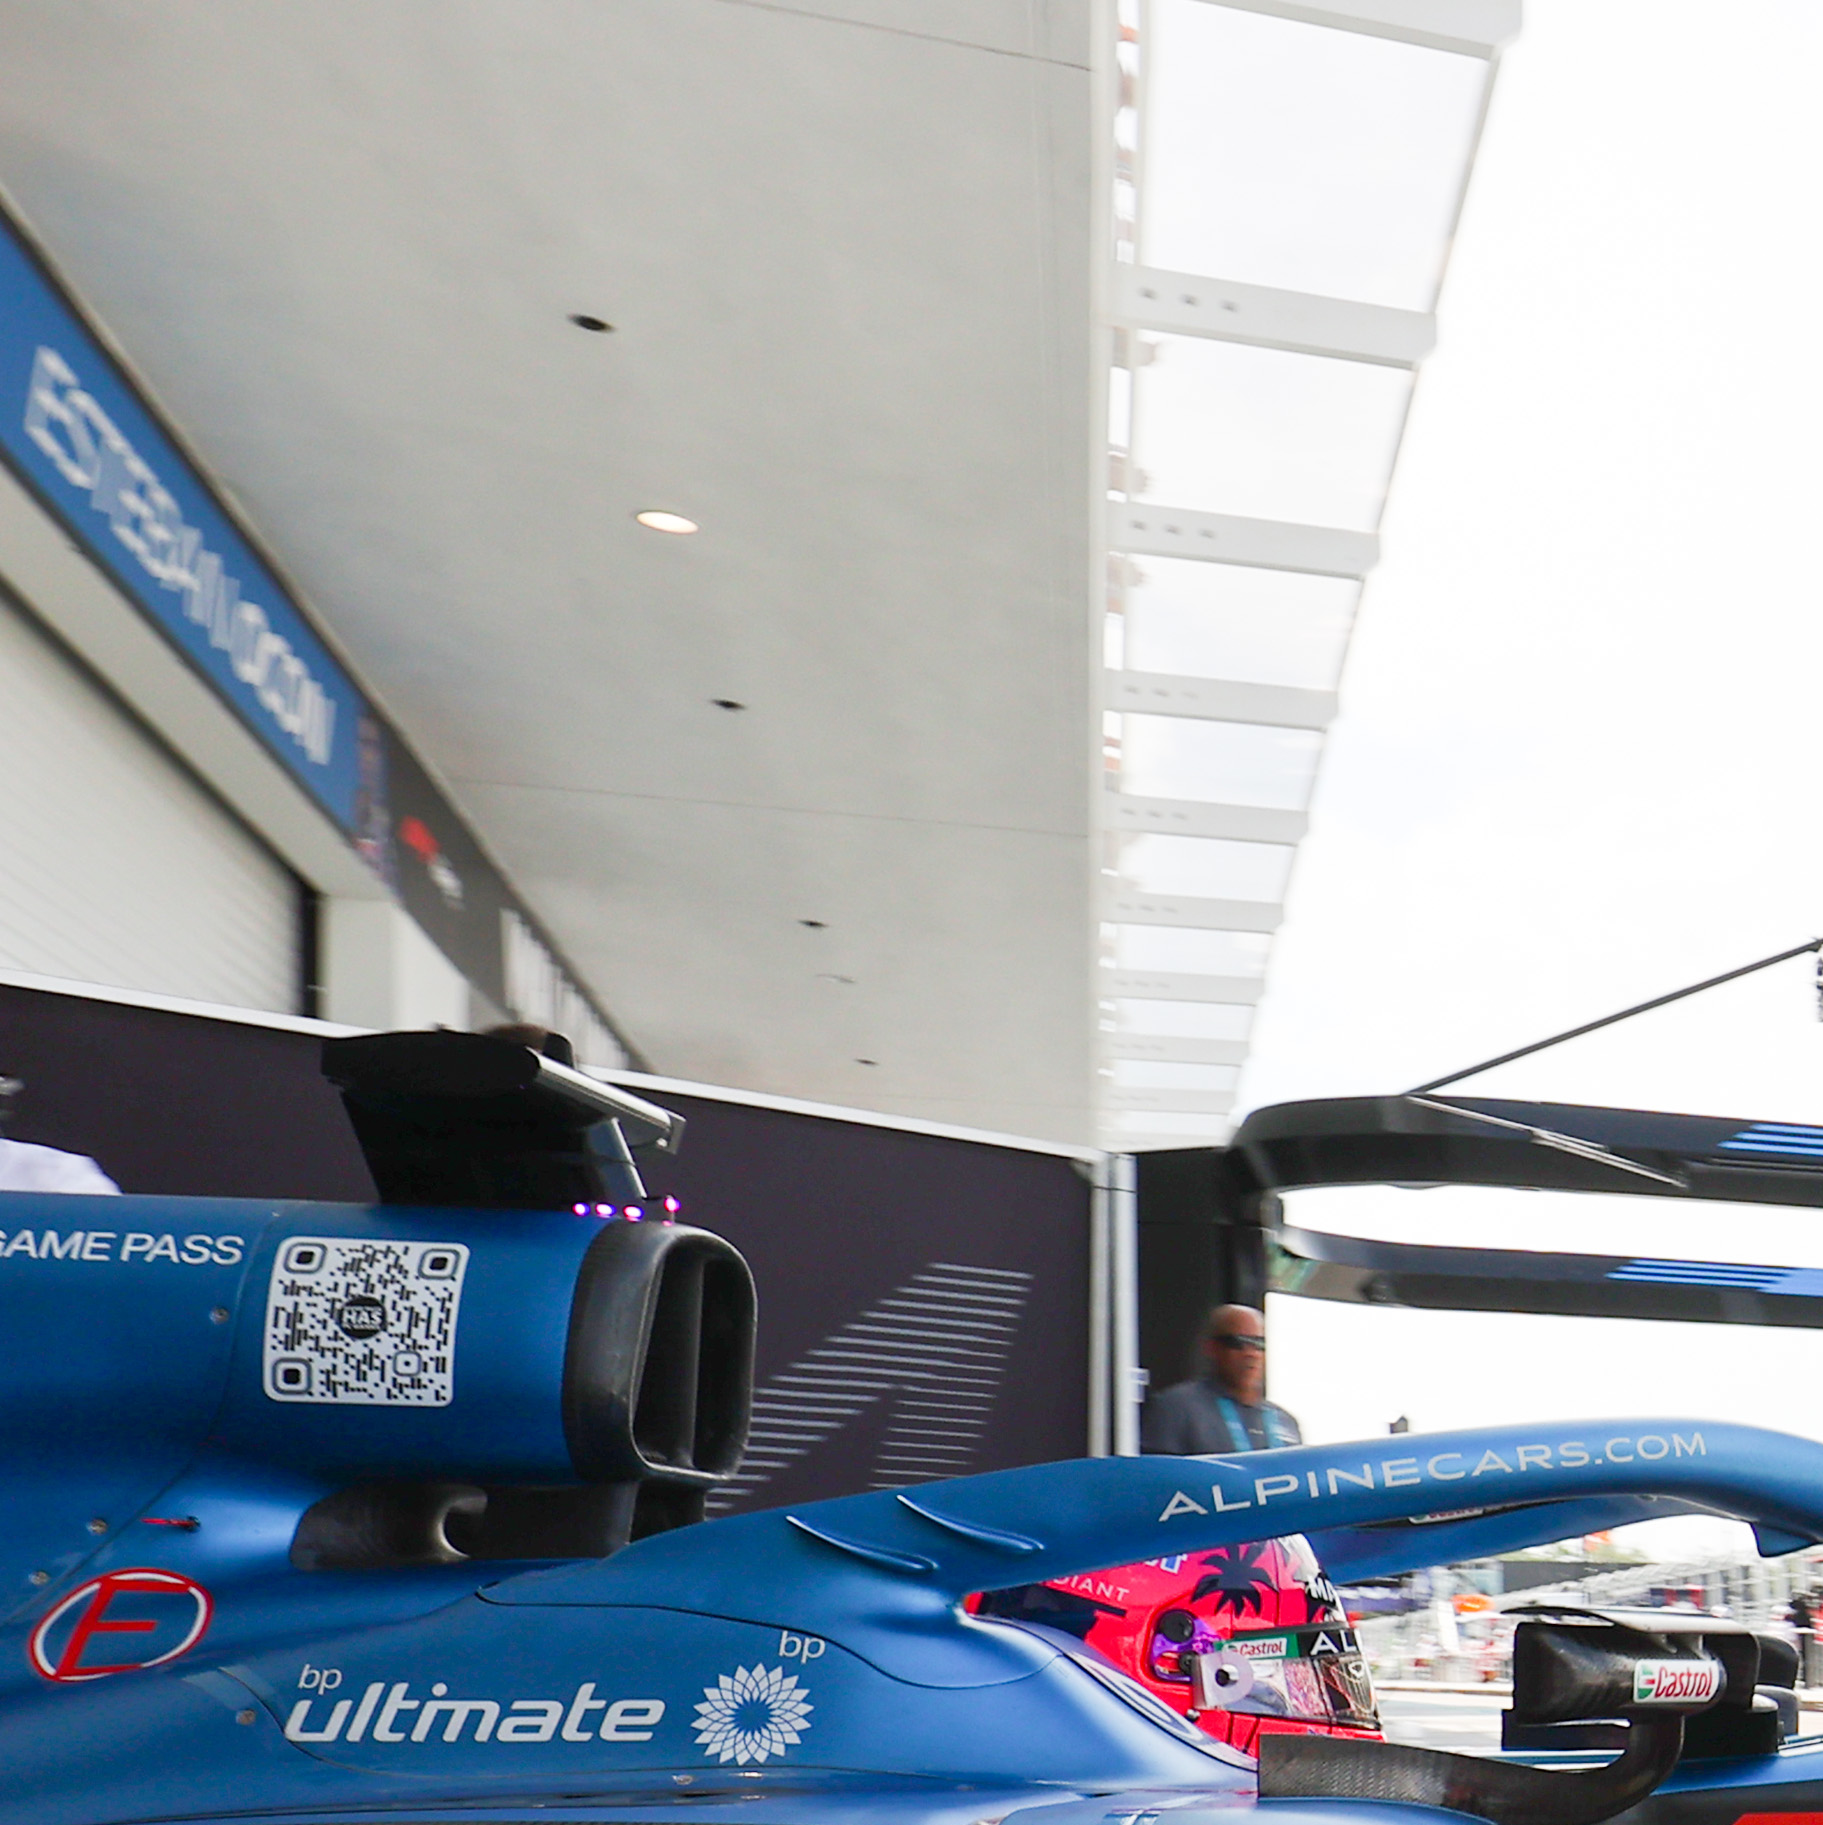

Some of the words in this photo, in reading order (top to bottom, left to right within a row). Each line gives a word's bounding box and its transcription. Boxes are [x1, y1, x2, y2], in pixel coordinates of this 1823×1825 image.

[119, 1232, 245, 1266] PASS
[1159, 1431, 1707, 1524] ALPINECARS.COM
[780, 1630, 826, 1664] bp
[1239, 1641, 1284, 1658] Castrol
[299, 1664, 342, 1695] bp
[1654, 1664, 1713, 1700] Castrol
[283, 1681, 666, 1745] ultimate
